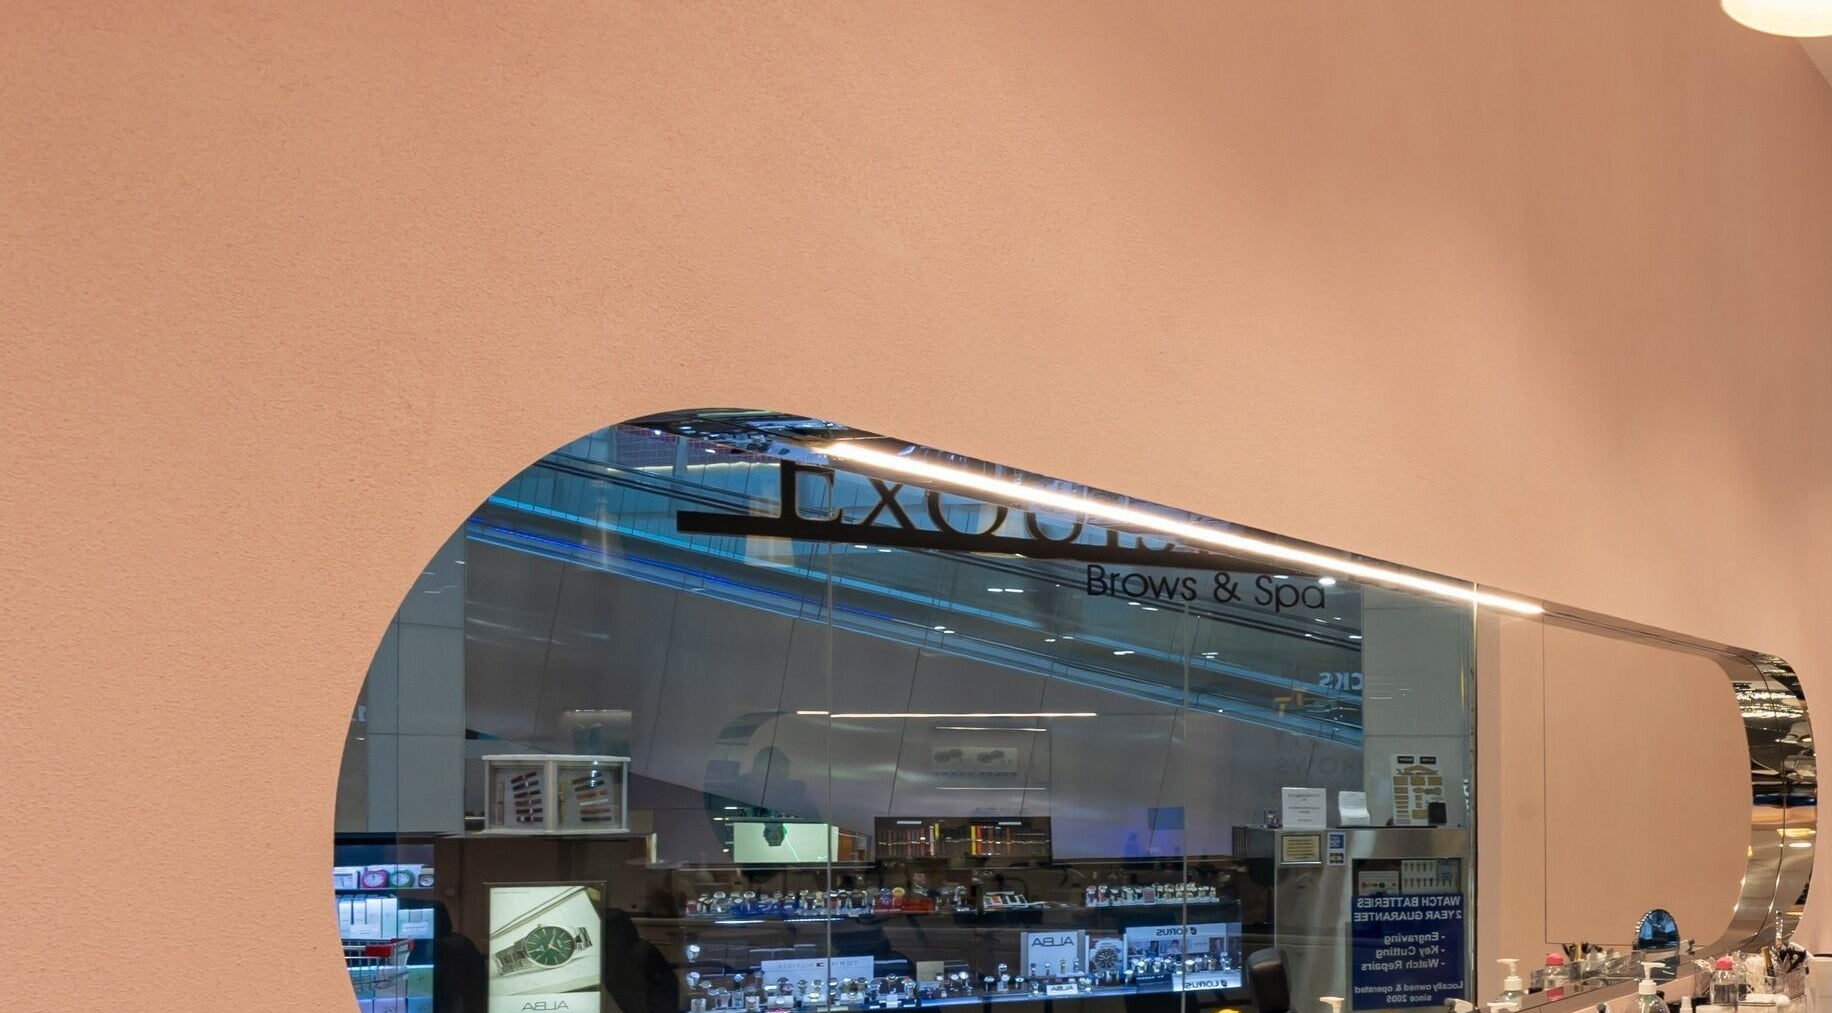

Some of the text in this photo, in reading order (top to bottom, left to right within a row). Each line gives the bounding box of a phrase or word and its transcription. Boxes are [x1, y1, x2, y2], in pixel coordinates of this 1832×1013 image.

[1087, 564, 1326, 613] Brows & Spa
